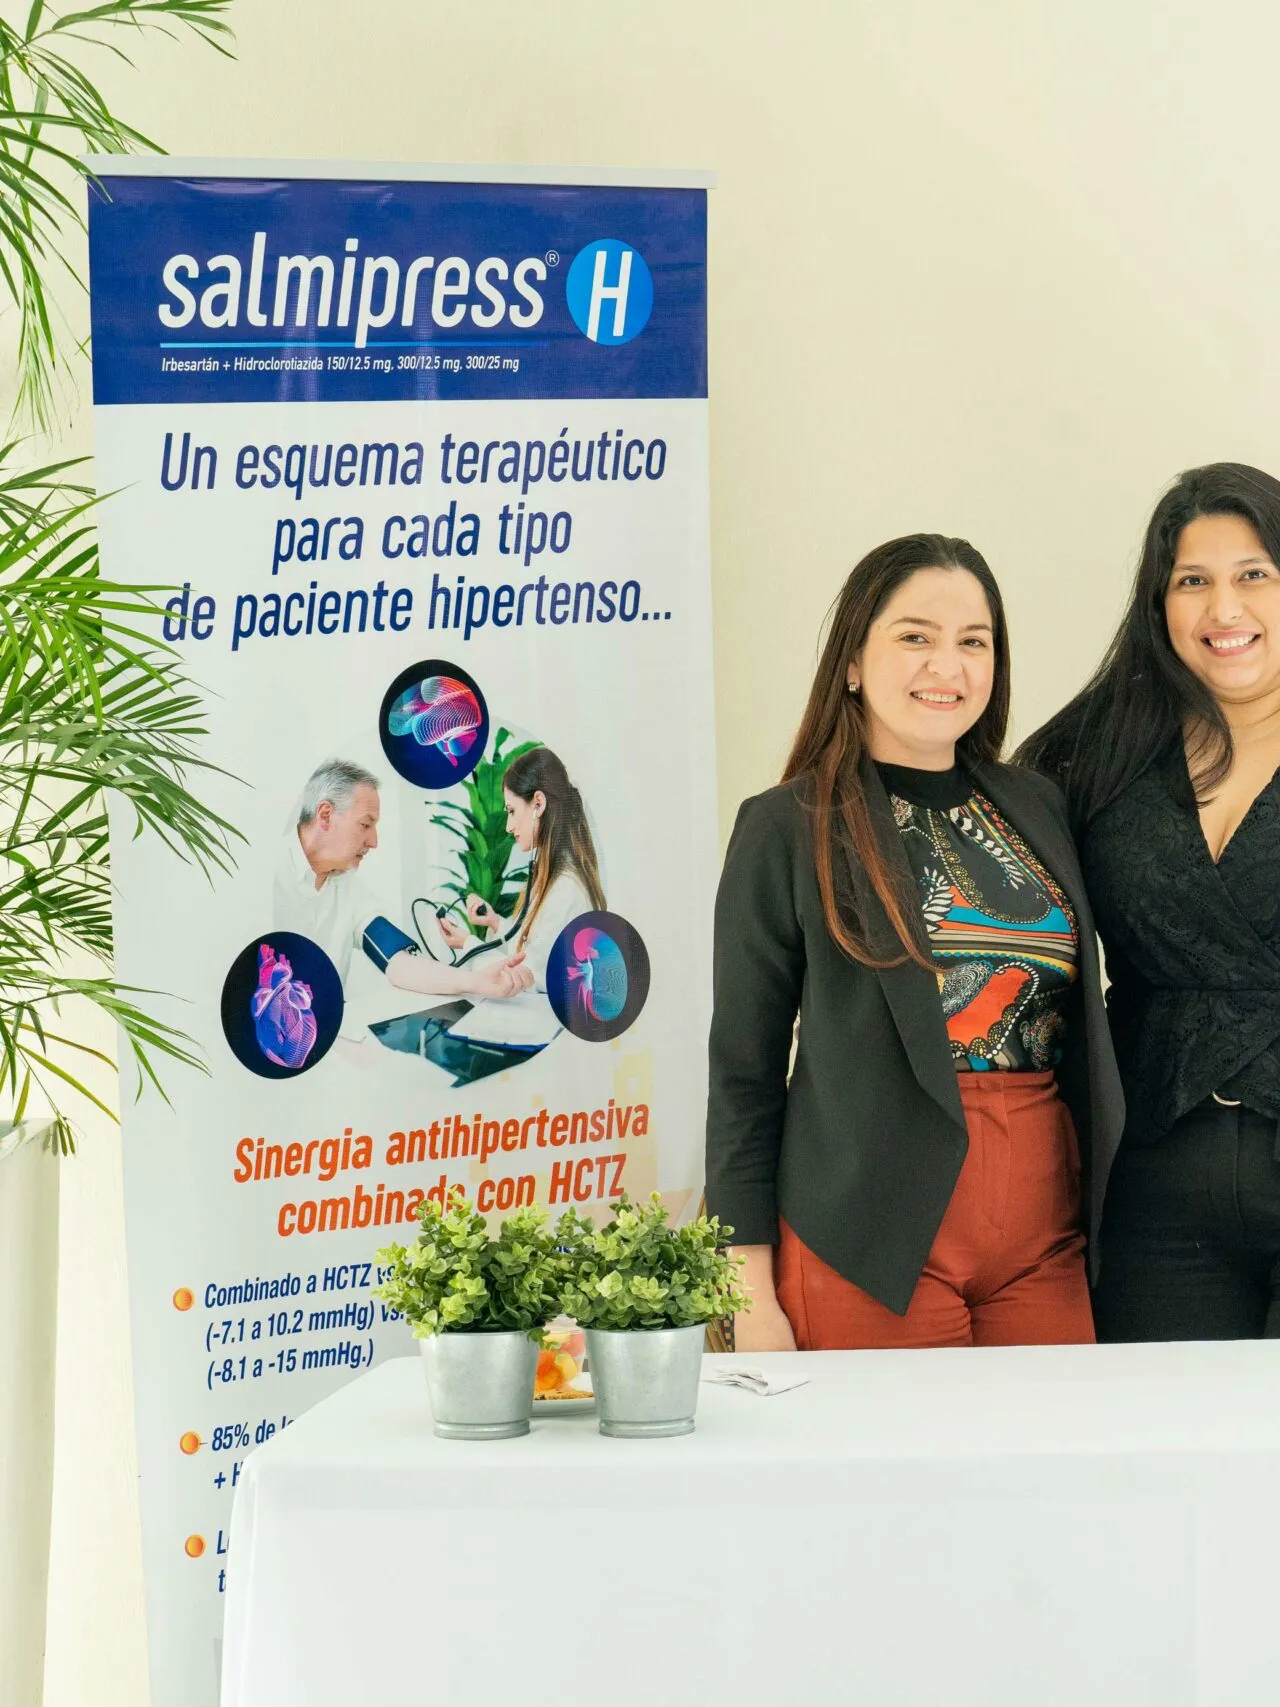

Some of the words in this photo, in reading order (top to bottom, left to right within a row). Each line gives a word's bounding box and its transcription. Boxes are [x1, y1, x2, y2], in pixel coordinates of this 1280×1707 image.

[588, 250, 633, 342] H
[162, 358, 219, 371] Irbesartán
[235, 357, 323, 370] Hidroclorotiazida
[326, 356, 371, 370] 150/12.5
[397, 356, 440, 370] 300/12.5
[466, 356, 501, 370] 300/25
[161, 432, 217, 491] Un
[235, 442, 424, 501] esquema
[441, 427, 667, 495] terapéutico
[272, 516, 364, 576] para
[382, 500, 481, 559] cada
[498, 502, 572, 567] tipo
[163, 583, 215, 641] de
[231, 580, 413, 652] paciente
[428, 573, 671, 641] hipertenso...
[234, 1128, 373, 1183] Sinergia
[386, 1099, 649, 1165] antihipertensiva
[477, 1174, 536, 1214] con
[549, 1153, 627, 1205] HCTZ
[205, 1273, 300, 1308] Combinado
[323, 1263, 372, 1291] HCTZ
[206, 1317, 245, 1353] (-7.1
[268, 1309, 303, 1337] 10.2
[308, 1300, 375, 1331] mmHg)
[207, 1356, 247, 1390] (-8.1
[269, 1348, 297, 1373] -15
[302, 1338, 374, 1370] mmHg.)
[212, 1421, 250, 1452] 85%
